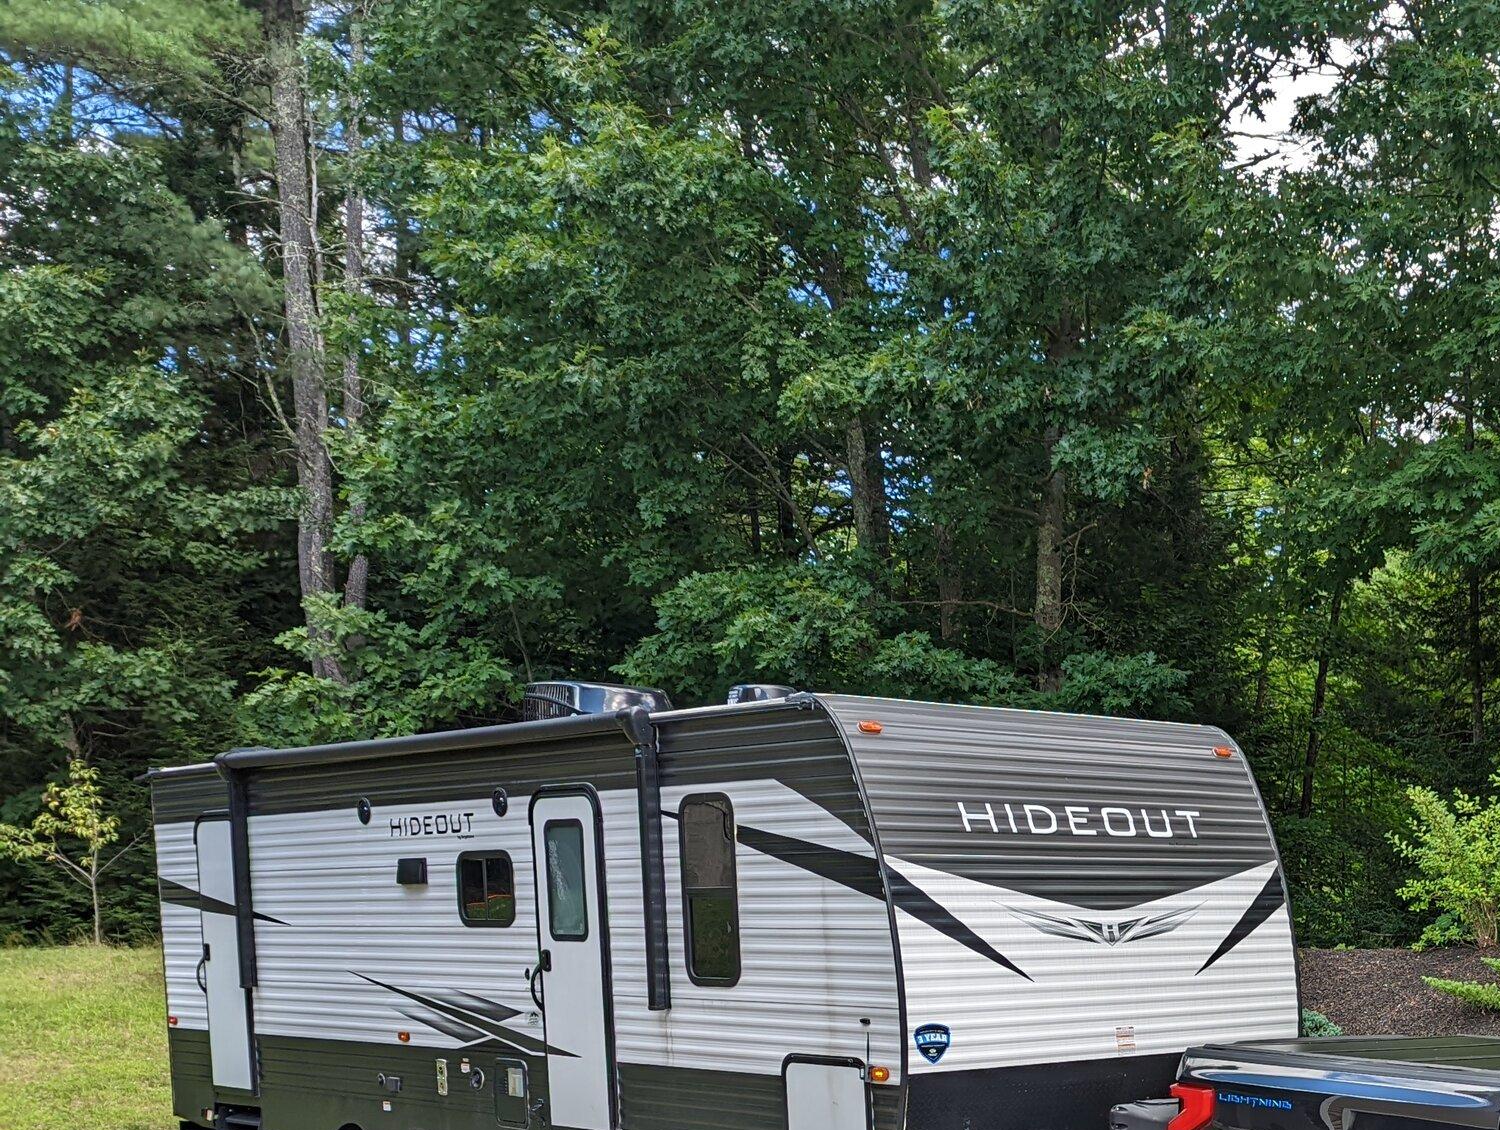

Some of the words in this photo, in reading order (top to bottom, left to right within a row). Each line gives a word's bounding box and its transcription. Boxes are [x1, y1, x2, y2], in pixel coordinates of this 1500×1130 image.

[389, 812, 474, 837] HIDEOUT
[957, 801, 1200, 838] HIDEOUT
[925, 1033, 948, 1043] YEAR
[1218, 1093, 1293, 1110] LIGHTNING
